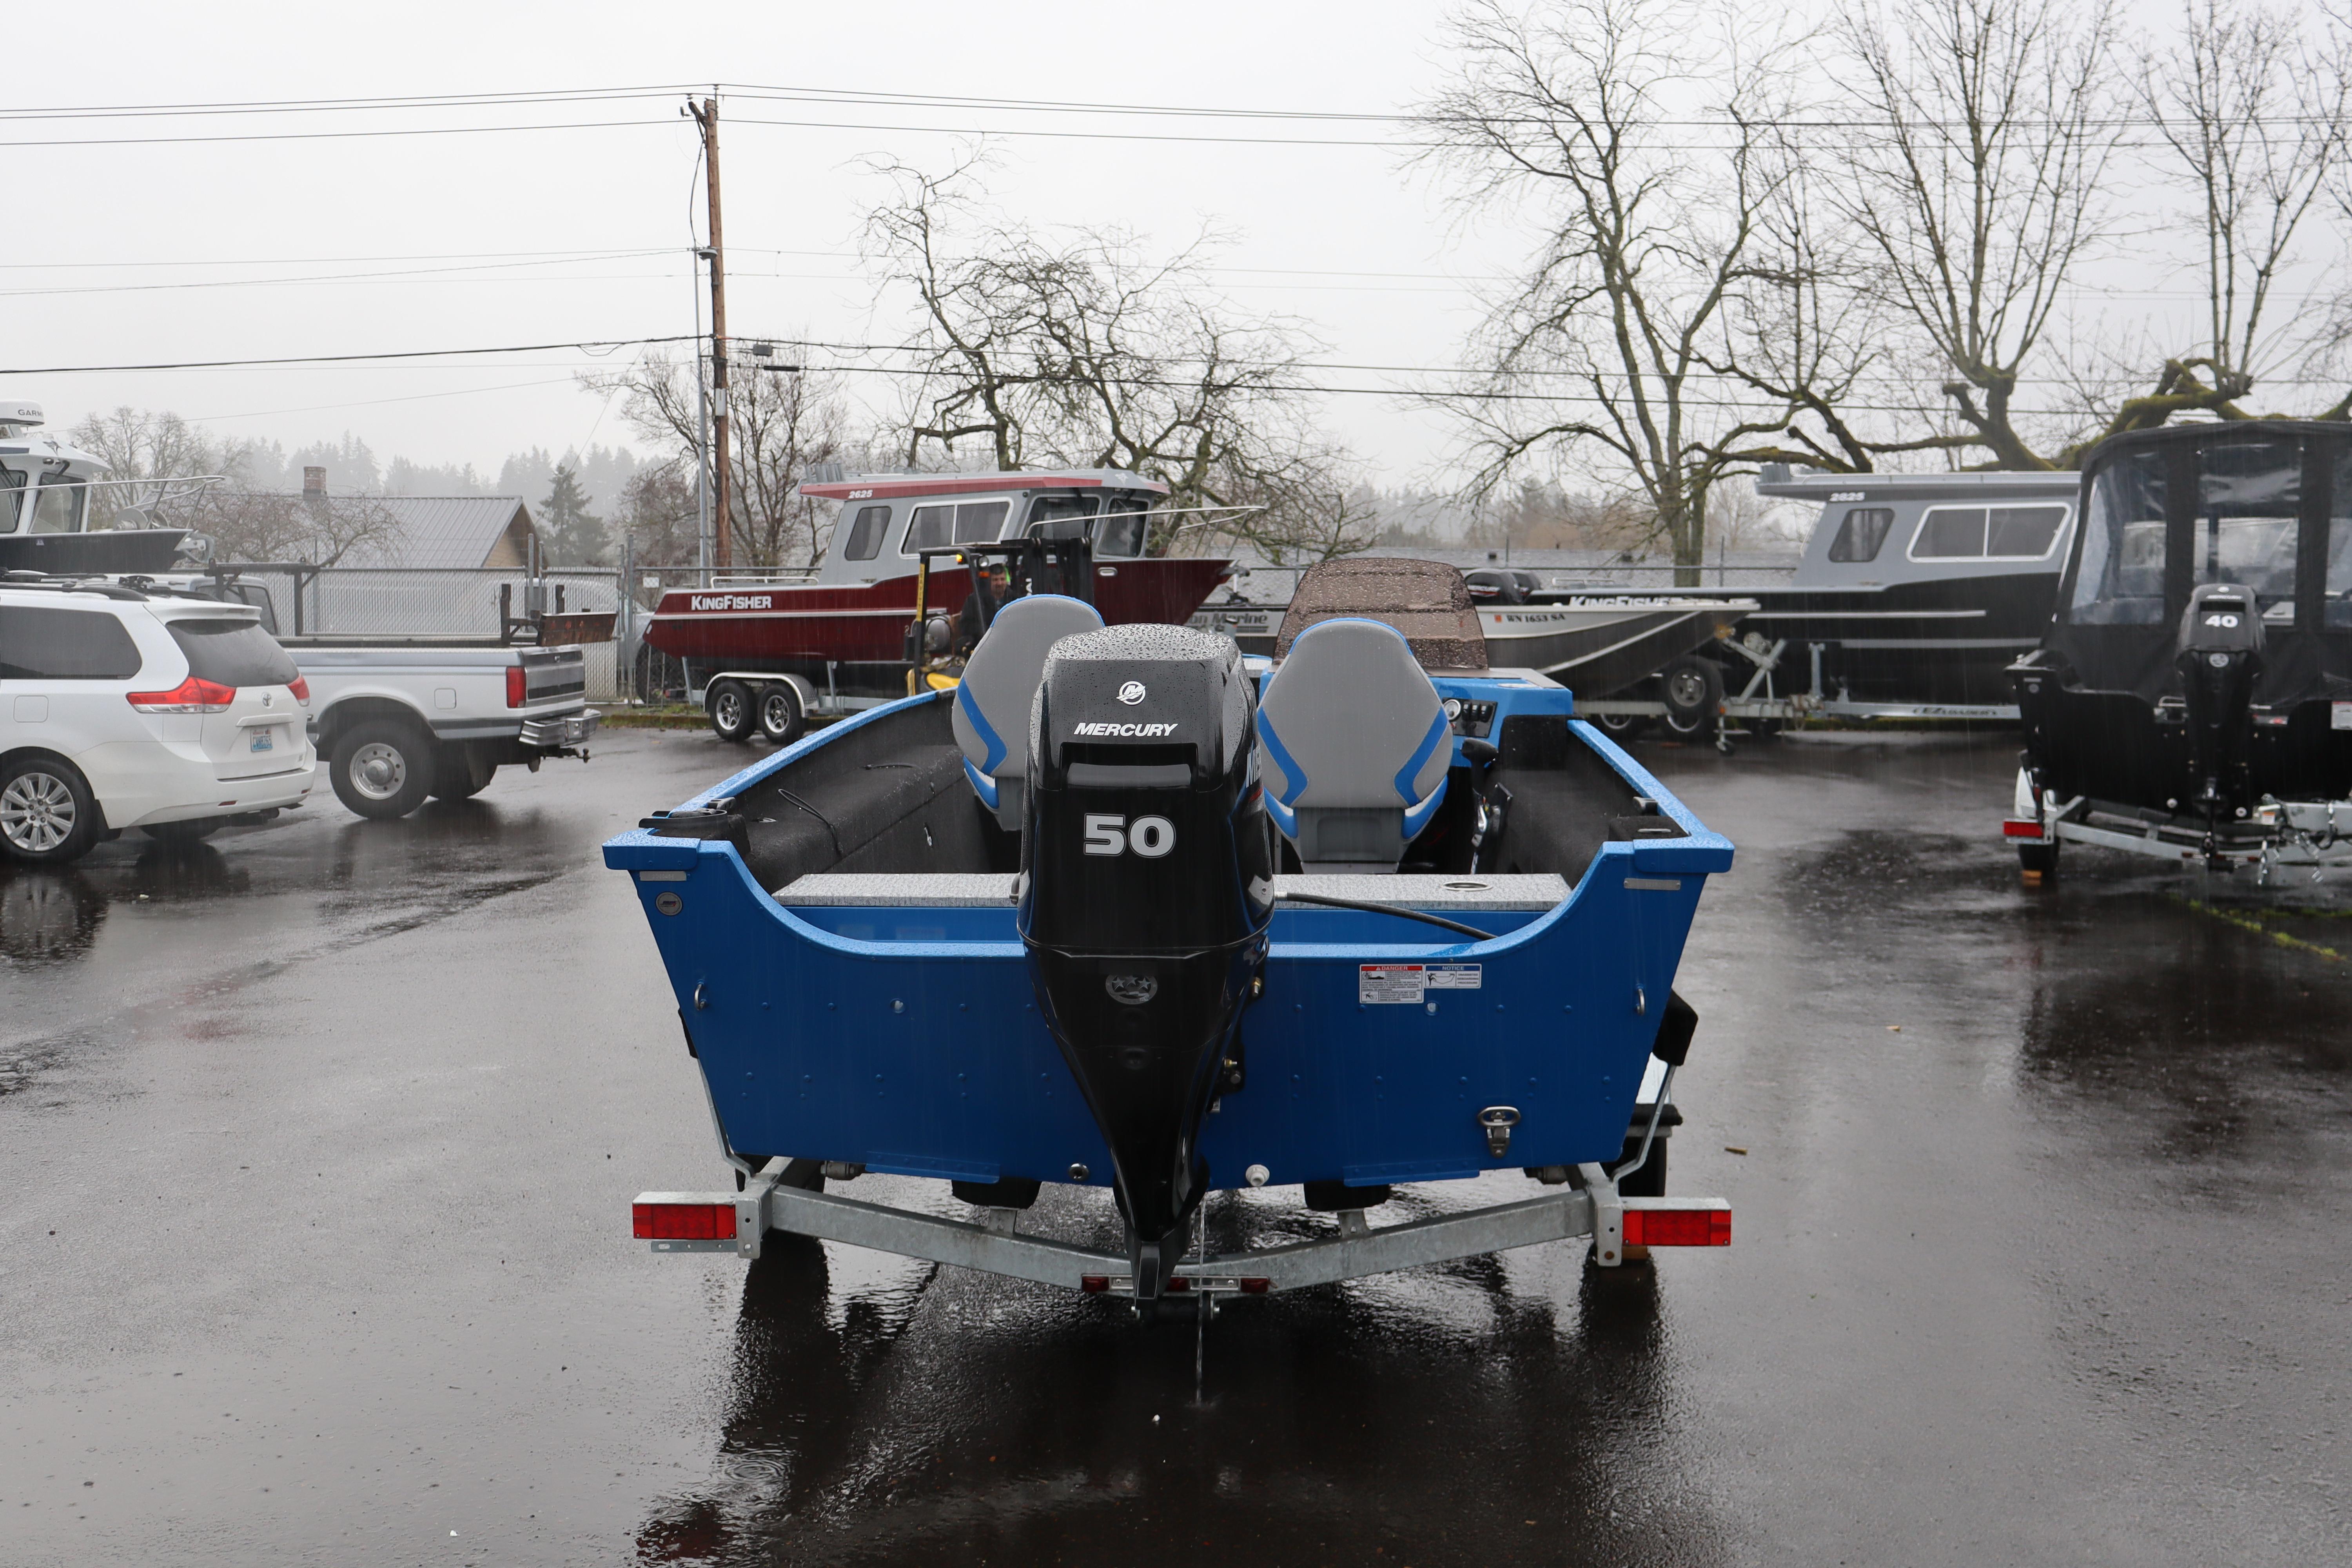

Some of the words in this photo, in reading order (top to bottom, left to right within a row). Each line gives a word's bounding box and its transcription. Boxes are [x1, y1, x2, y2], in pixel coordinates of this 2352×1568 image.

[848, 489, 873, 499] 2625
[691, 595, 772, 611] KINGFISHER
[1525, 614, 1548, 622] 1653
[1550, 613, 1565, 621] SA
[2205, 615, 2238, 628] 40
[1074, 722, 1178, 737] MERCURY
[1083, 813, 1176, 858] 50
